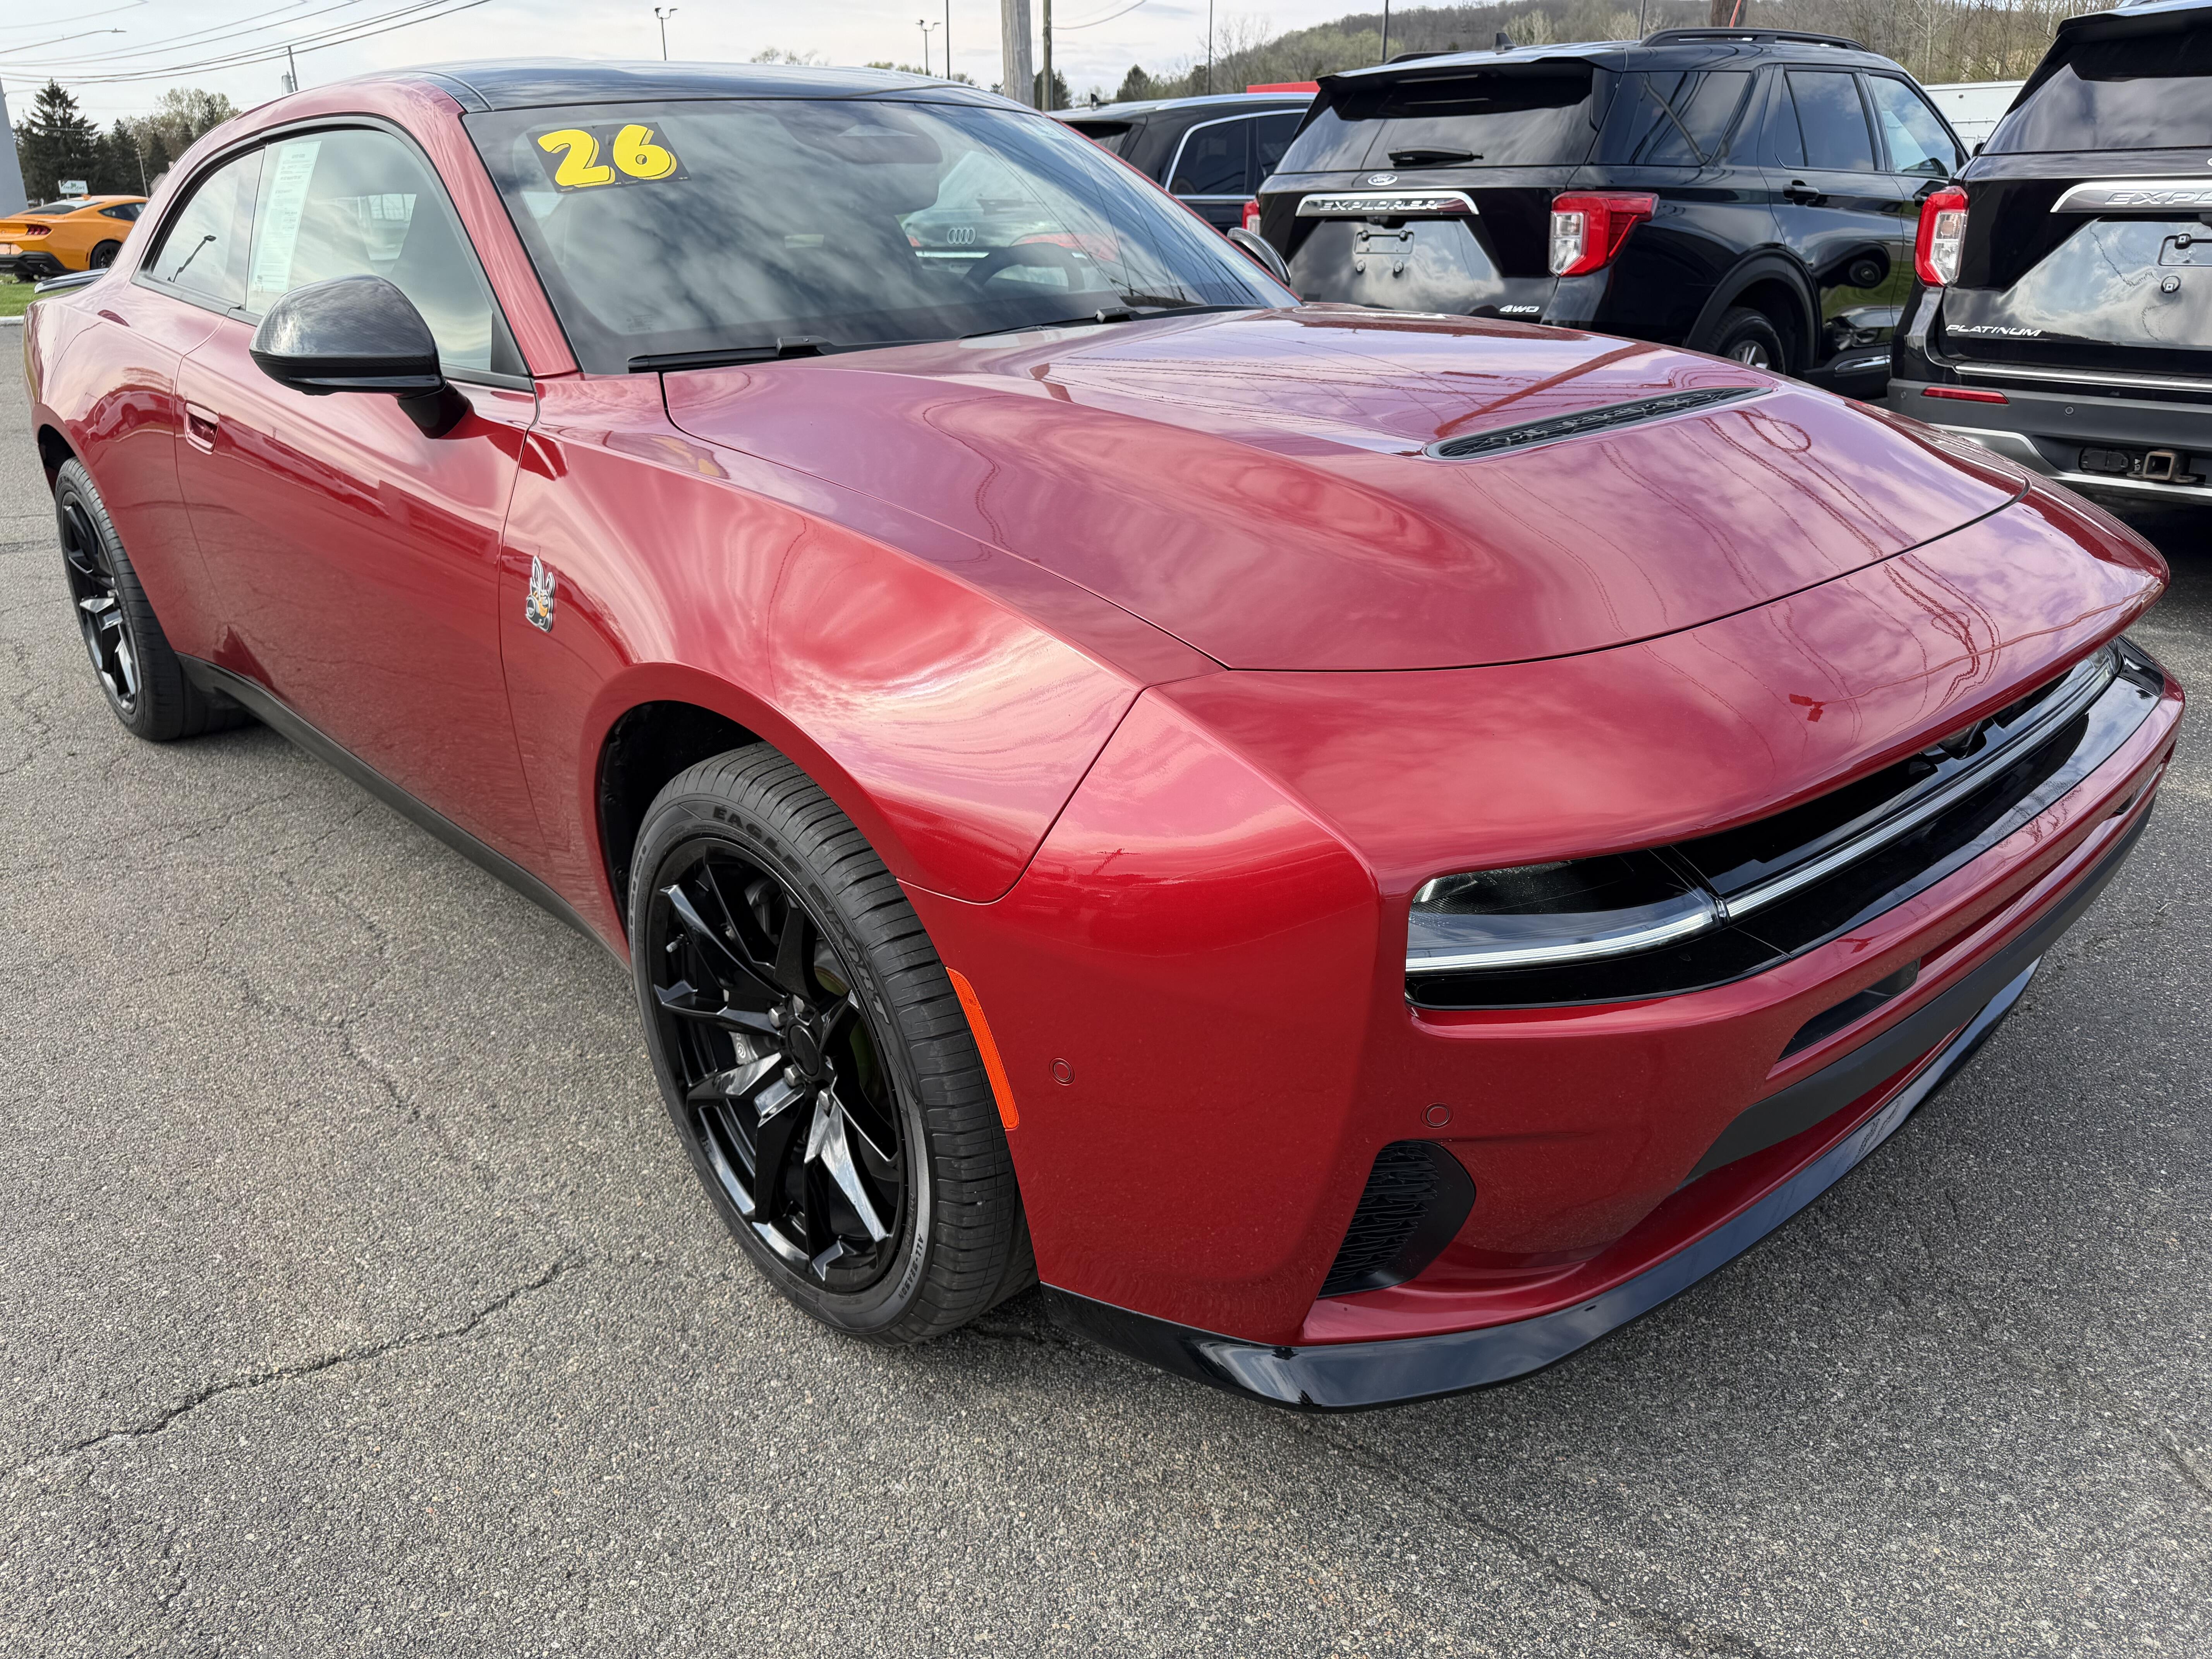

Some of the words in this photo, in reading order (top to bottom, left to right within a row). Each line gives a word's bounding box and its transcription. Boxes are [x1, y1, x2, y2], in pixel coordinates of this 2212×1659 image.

[538, 124, 677, 188] 26
[1319, 200, 1438, 211] EXPLORER
[1499, 305, 1540, 313] 4WD
[1946, 325, 2042, 337] PLATINUM
[713, 805, 803, 875] EAGLE
[808, 883, 890, 1025] SPORT
[898, 1233, 924, 1301] ALL-SEASON
